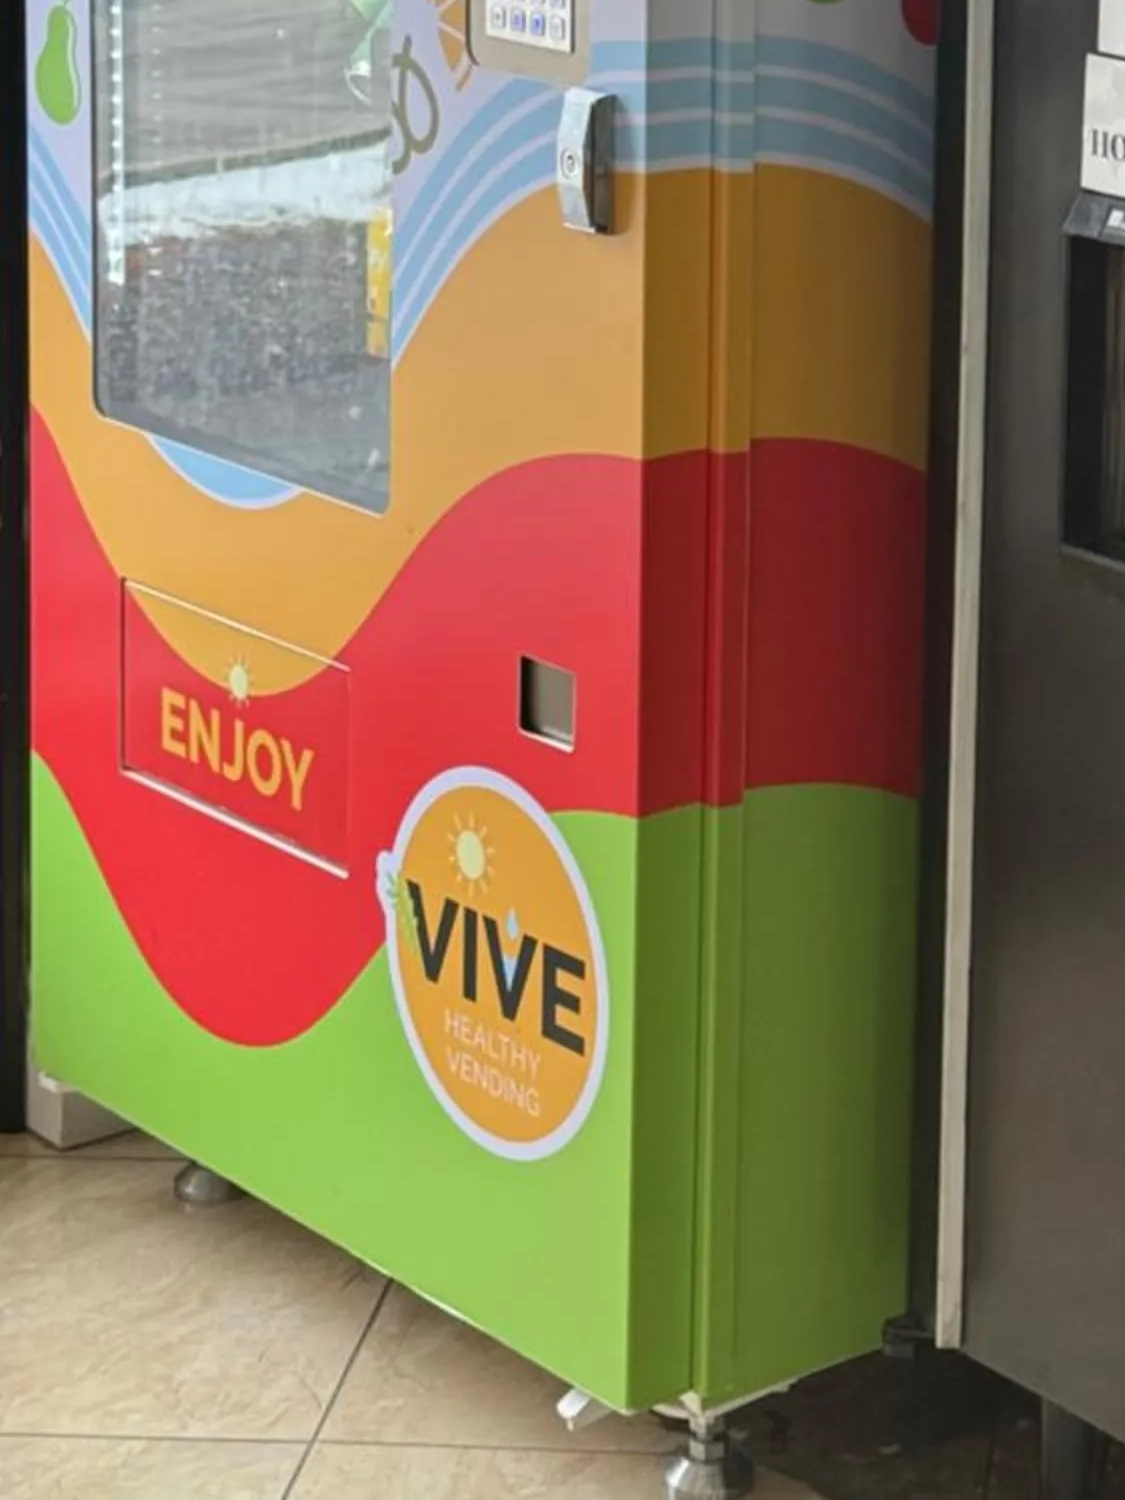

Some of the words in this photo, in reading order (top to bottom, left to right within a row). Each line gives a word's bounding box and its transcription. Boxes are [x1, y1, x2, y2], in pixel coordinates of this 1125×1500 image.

[161, 686, 315, 812] ENJOY
[406, 878, 586, 1057] VIVE
[443, 1008, 541, 1075] HEALTHY
[445, 1046, 540, 1117] VENDING
